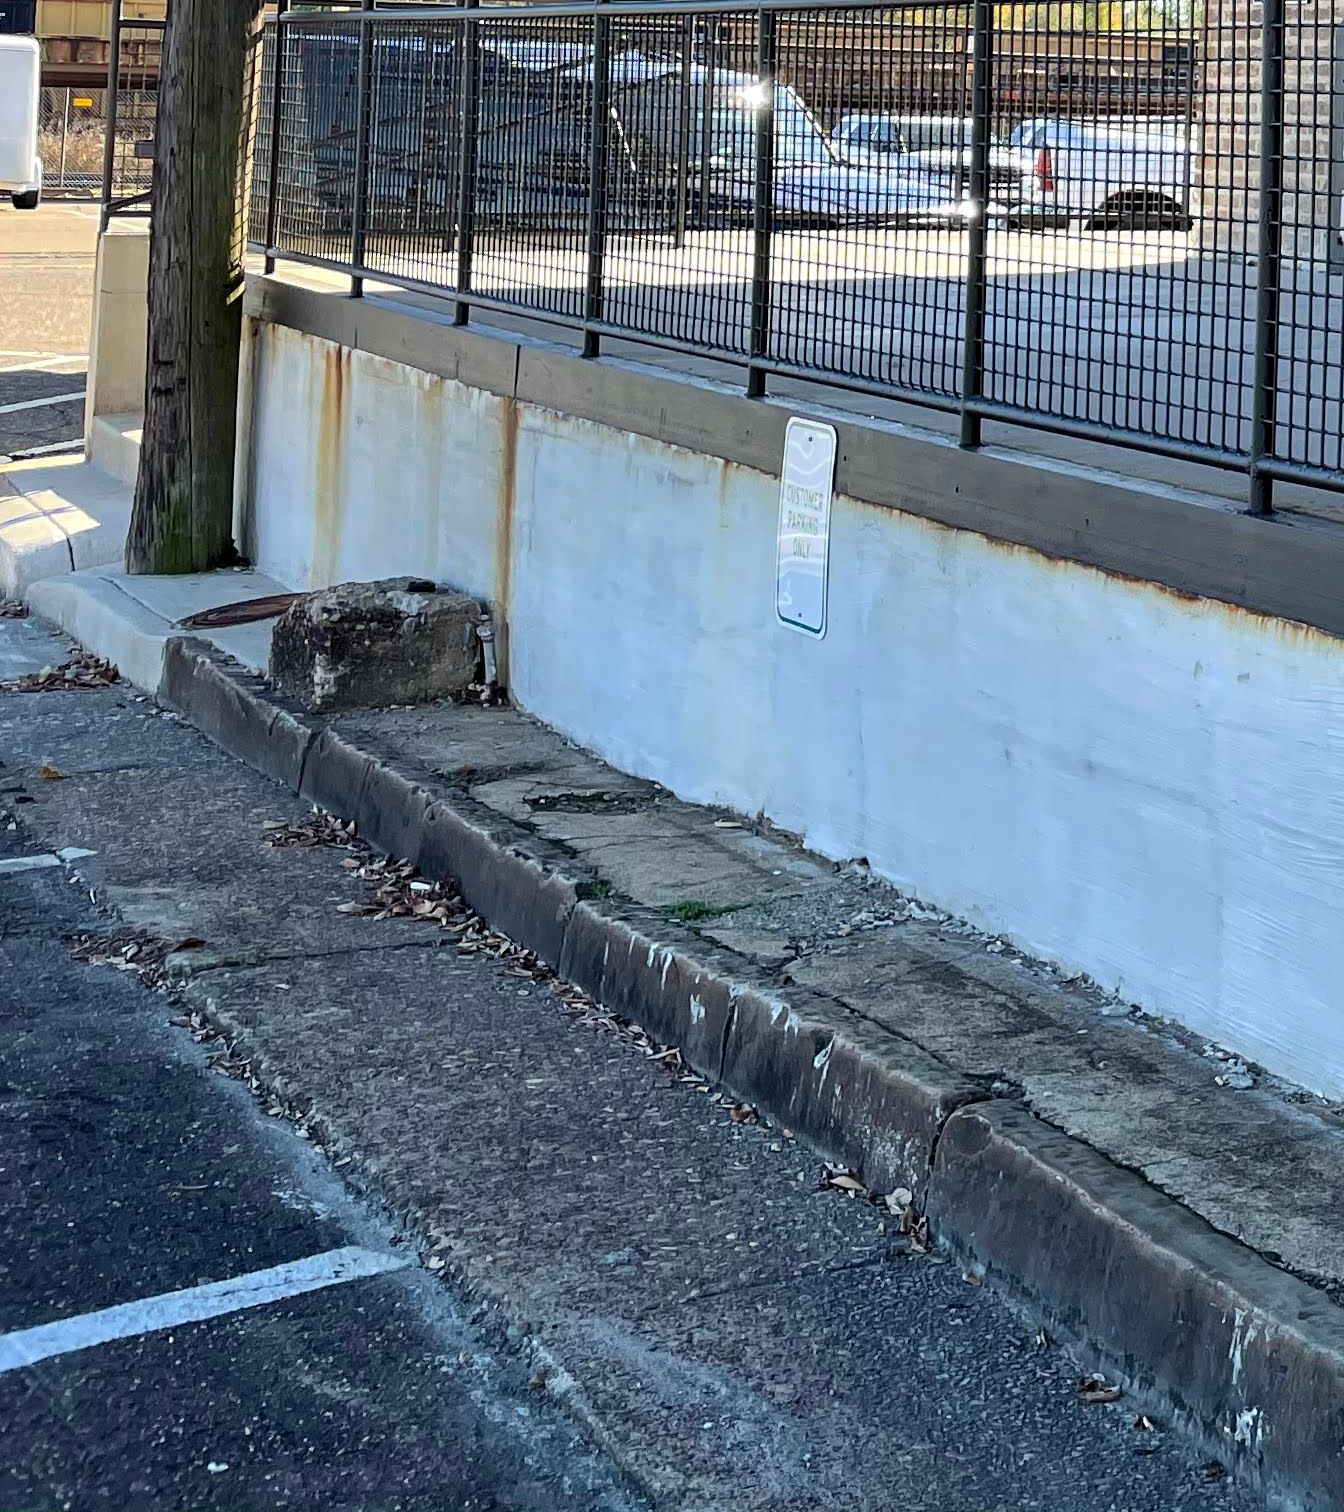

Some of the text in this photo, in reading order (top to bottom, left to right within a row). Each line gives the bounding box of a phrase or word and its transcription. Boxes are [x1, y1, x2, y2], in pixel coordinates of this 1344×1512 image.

[786, 483, 823, 512] CUSTOMER
[788, 510, 818, 536] PARKING
[792, 536, 811, 559] ONLY
